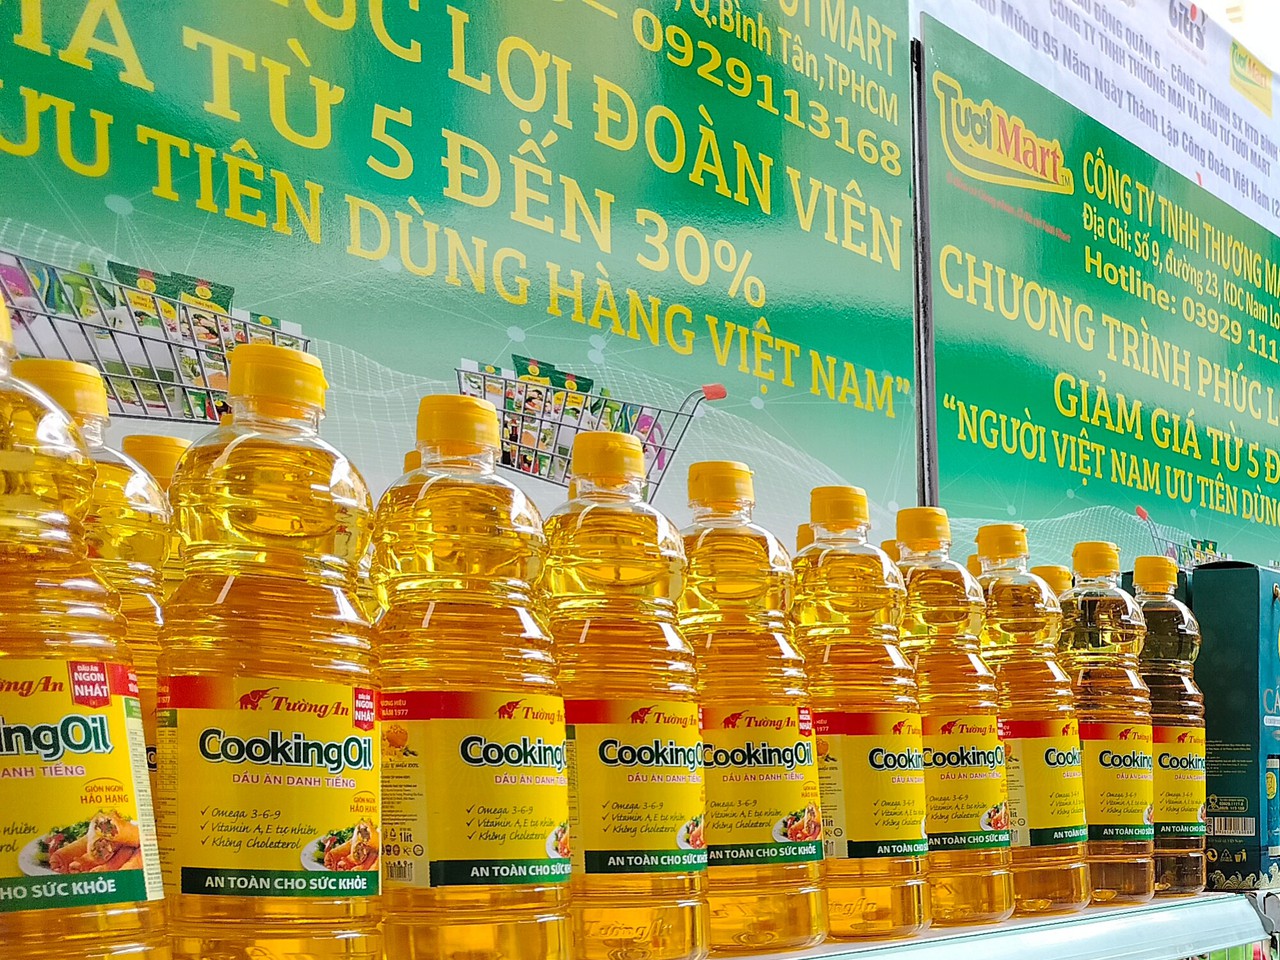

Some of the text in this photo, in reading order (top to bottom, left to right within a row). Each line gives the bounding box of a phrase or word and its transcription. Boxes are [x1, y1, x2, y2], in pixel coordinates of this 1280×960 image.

[820, 0, 898, 77] MART
[1083, 20, 1097, 45] TY
[1099, 31, 1126, 68] TNHH
[632, 7, 902, 176] 0929113168
[1125, 27, 1231, 124] QUẬN CÔNG TNHH
[1001, 3, 1038, 50] Mừng
[1043, 31, 1058, 61] 95
[1062, 44, 1091, 85] Năm
[1094, 67, 1123, 109] Ngày
[1127, 90, 1158, 133] Thành
[1182, 131, 1206, 168] Công
[1208, 148, 1230, 180] Đoàn
[1250, 181, 1269, 211] Nam
[446, 4, 573, 136] LỢI
[593, 75, 773, 215] ĐOÀN
[786, 165, 902, 271] VIÊN
[996, 114, 1061, 184] Mart
[182, 26, 345, 150] TỪ
[366, 103, 414, 180] 5
[441, 127, 615, 255] ĐẾN
[635, 207, 766, 309] 30%
[1083, 147, 1132, 215] CÔNG
[1135, 181, 1155, 228] TY
[1158, 195, 1199, 254] TNHH
[1203, 221, 1262, 288] THƯƠNG
[137, 125, 324, 244] TIÊN
[344, 194, 530, 305] DÙNG
[546, 261, 695, 355] HÀNG
[705, 314, 799, 395] VIỆT
[1083, 201, 1105, 241] Địa
[1108, 216, 1132, 253] Chỉ:
[1134, 230, 1150, 262] Số
[1165, 247, 1204, 297] đường
[1205, 269, 1221, 304] 23,
[1223, 279, 1244, 312] KDC
[1246, 293, 1268, 325] Nam
[1085, 245, 1176, 315] Hotline:
[1182, 295, 1242, 346] 03929
[939, 244, 1095, 352] CHƯƠNG
[1101, 315, 1191, 397] TRÌNH
[1197, 357, 1262, 421] PHÚC
[1053, 371, 1144, 442] GIẢM
[1151, 407, 1202, 461] GIÁ
[1206, 420, 1244, 472] TỪ
[1247, 447, 1259, 478] 5
[942, 393, 1046, 464] “NGƯỜI
[1051, 426, 1106, 486] VIỆT
[1110, 450, 1160, 496] NAM
[1165, 467, 1194, 504] ƯU
[1197, 472, 1238, 516] TIÊN
[271, 695, 331, 717] Tường
[40, 762, 85, 777] TIẾNG
[199, 728, 373, 772] CookingOil
[232, 771, 260, 785] DẦU
[286, 776, 322, 788] DANH
[326, 774, 356, 788] TIẾNG
[459, 735, 567, 773] Cooking
[702, 741, 813, 770] CookingOil
[211, 808, 281, 821] Omega 3-6-9
[211, 820, 252, 834] Vitamin
[211, 834, 301, 853] Không Cholesterol
[205, 873, 367, 890] AN TOÀN CHO SỨC KHỎE
[470, 861, 550, 877] AN TOÀN CHO
[724, 847, 777, 858] TOÀN CHO
[32, 875, 117, 898] SỨC KHỎE
